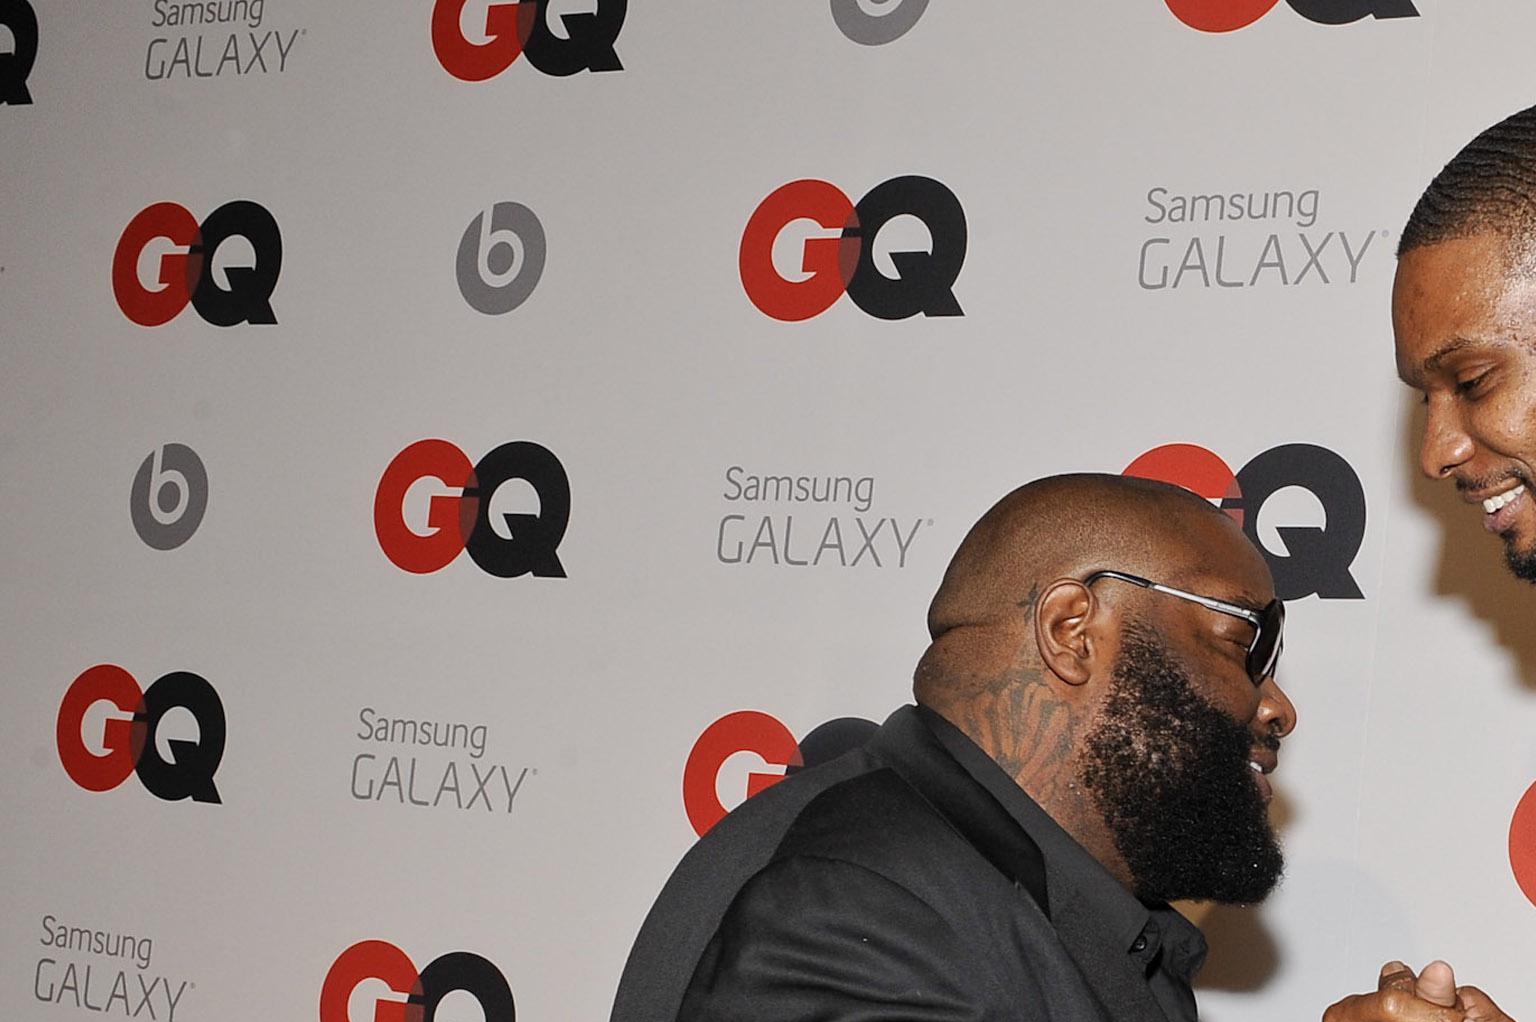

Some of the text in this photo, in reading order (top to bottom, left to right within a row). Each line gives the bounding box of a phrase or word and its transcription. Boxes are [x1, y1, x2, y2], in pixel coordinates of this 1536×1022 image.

[152, 0, 266, 28] Samsung
[431, 0, 628, 82] GQ
[1145, 188, 1320, 227] Samsung
[112, 200, 283, 327] GQ
[739, 175, 968, 323] GQ
[374, 439, 571, 578] GQ
[724, 467, 875, 513] Samsung
[56, 664, 226, 805] GQ
[356, 708, 488, 758] Samsung
[683, 710, 883, 838] G
[39, 915, 153, 969] Samsung
